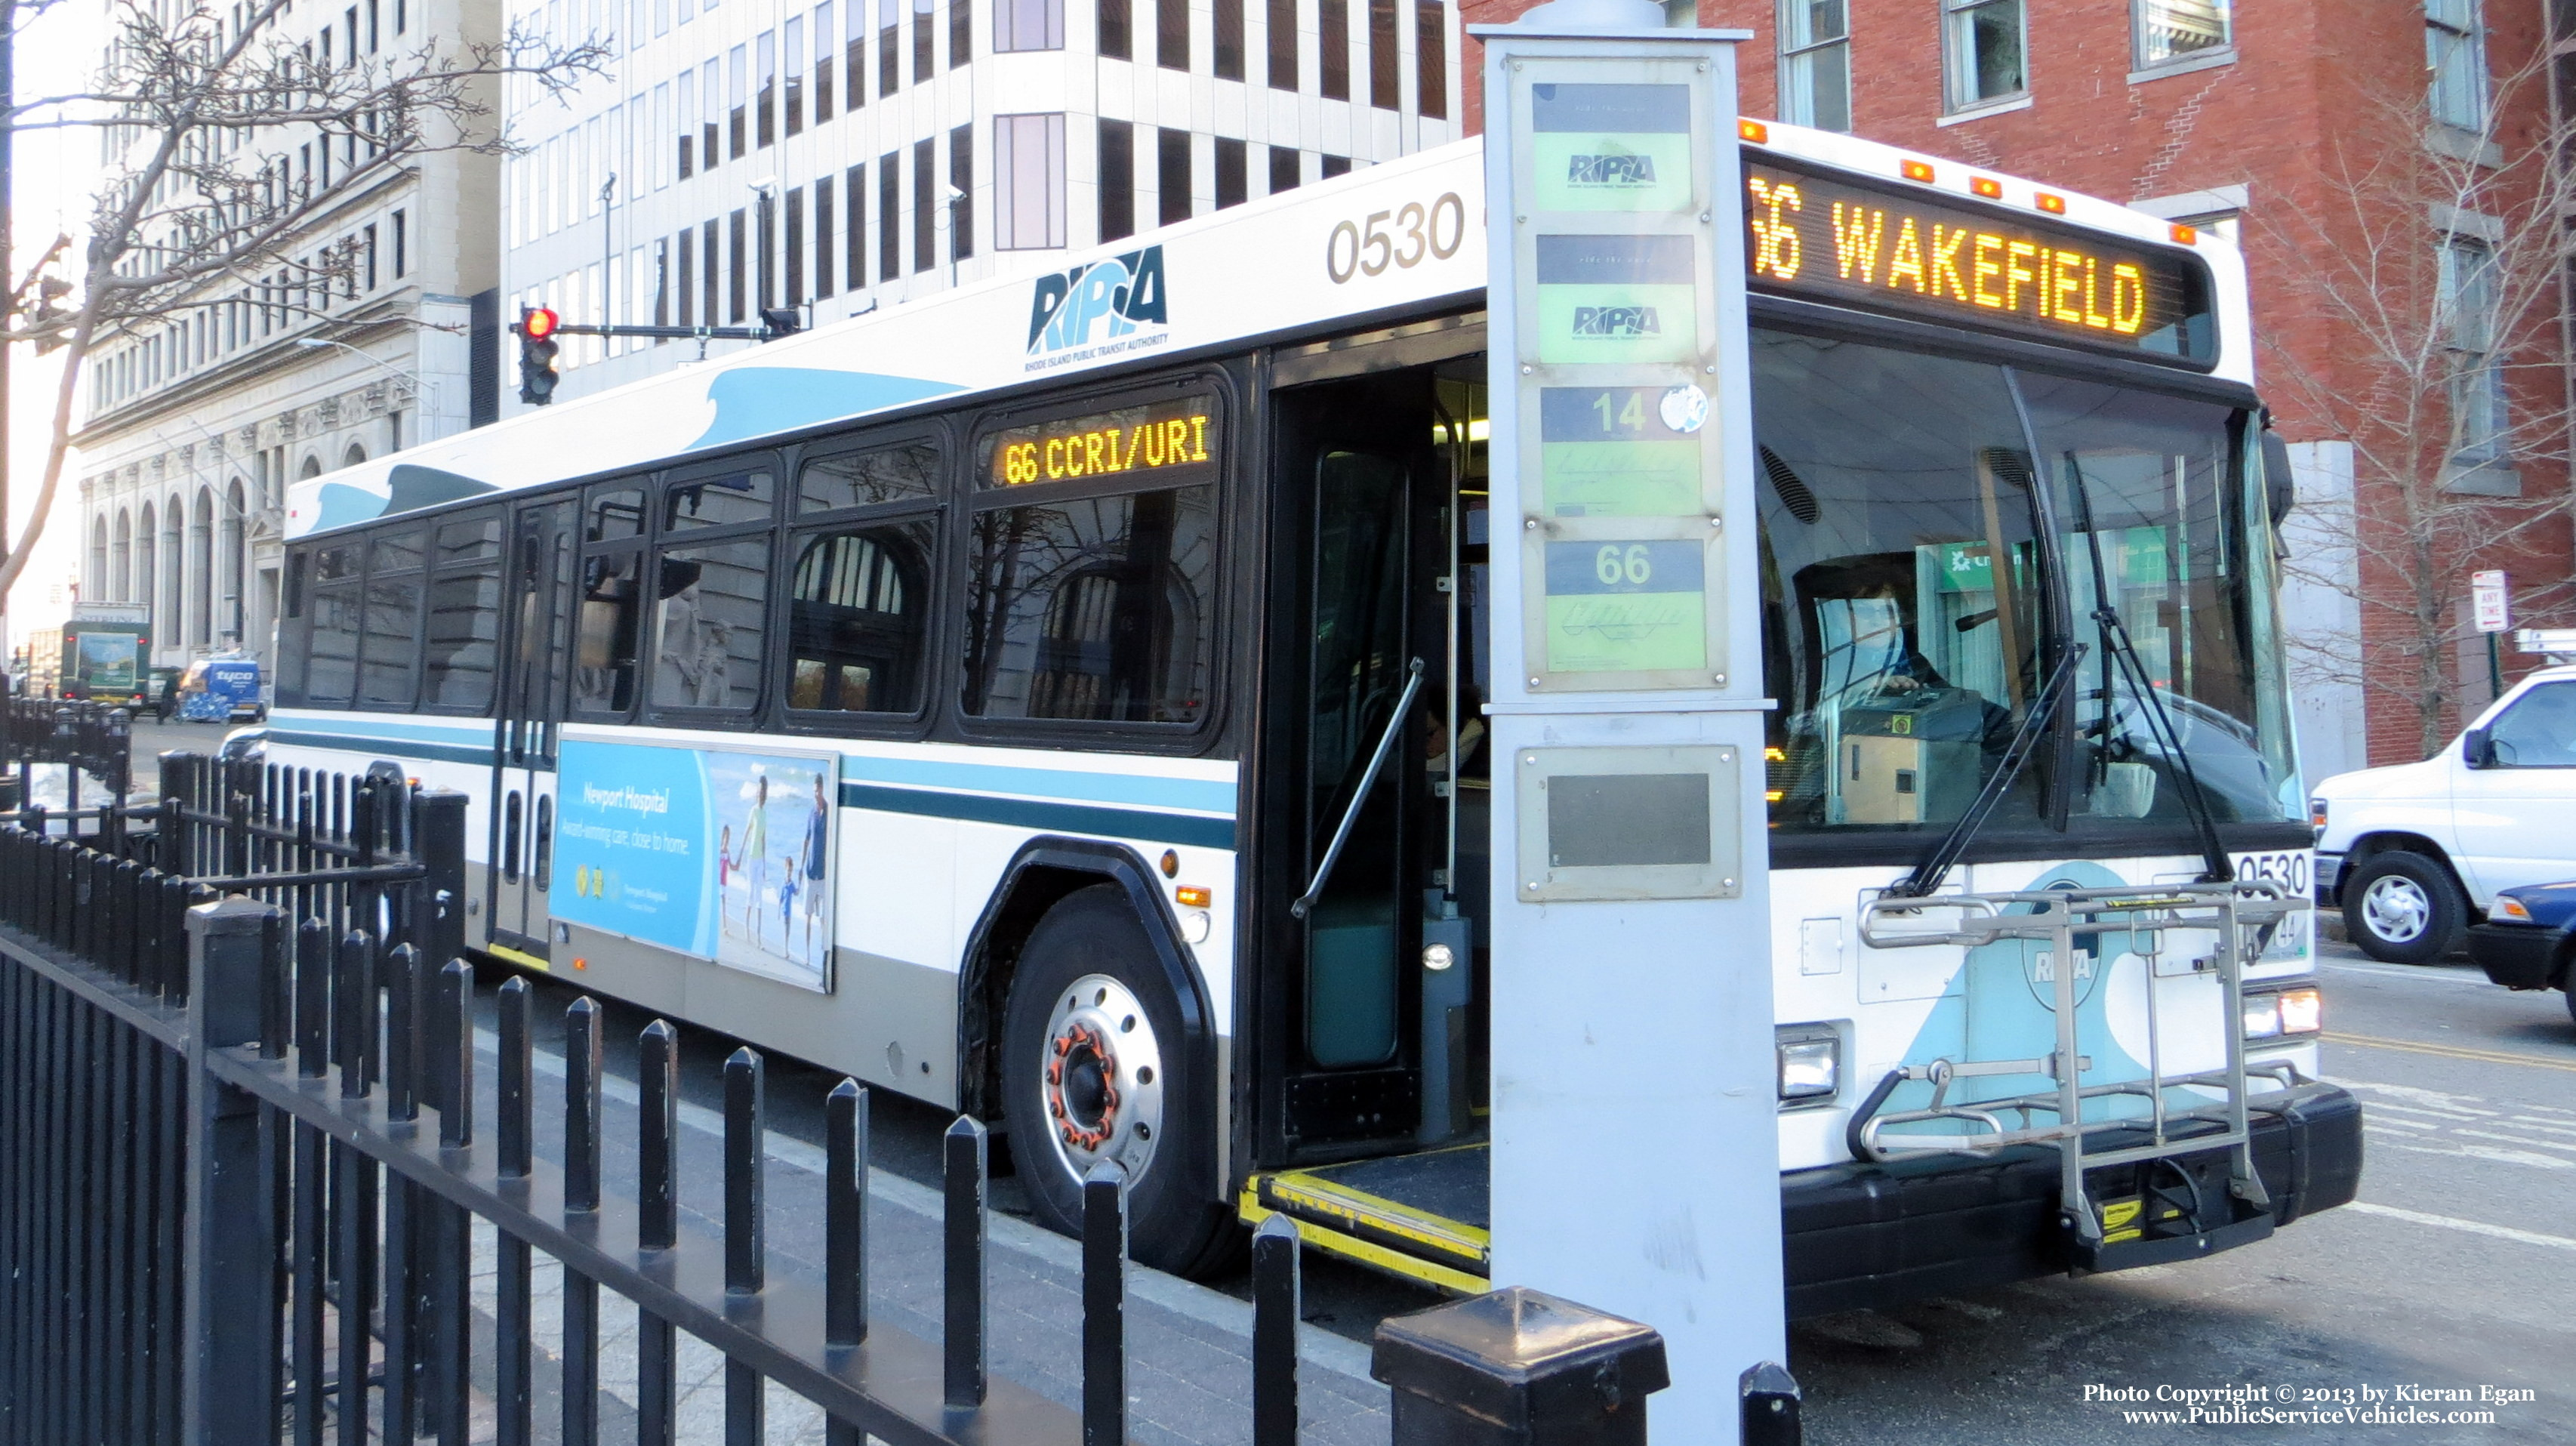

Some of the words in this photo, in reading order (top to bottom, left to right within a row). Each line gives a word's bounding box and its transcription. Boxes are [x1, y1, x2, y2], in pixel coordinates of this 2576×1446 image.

[1327, 192, 1464, 285] 0530
[1833, 201, 2144, 335] WAKEFIELD
[1025, 360, 1046, 372] RHODE
[1048, 355, 1072, 368] ISLAND
[1073, 349, 1095, 362] PUBLIC
[1098, 341, 1126, 357] TRANSIT
[1127, 333, 1169, 351] AUTHORITY
[1593, 392, 1647, 432] 14
[1006, 442, 1039, 484] 66
[1046, 415, 1208, 479] CCRI/URI
[1596, 544, 1652, 584] 66
[217, 671, 254, 683] tyco
[583, 782, 624, 813] Newport
[625, 785, 670, 819] Hospital
[652, 831, 662, 850] to
[664, 831, 690, 856] home.
[2239, 853, 2306, 899] 0530
